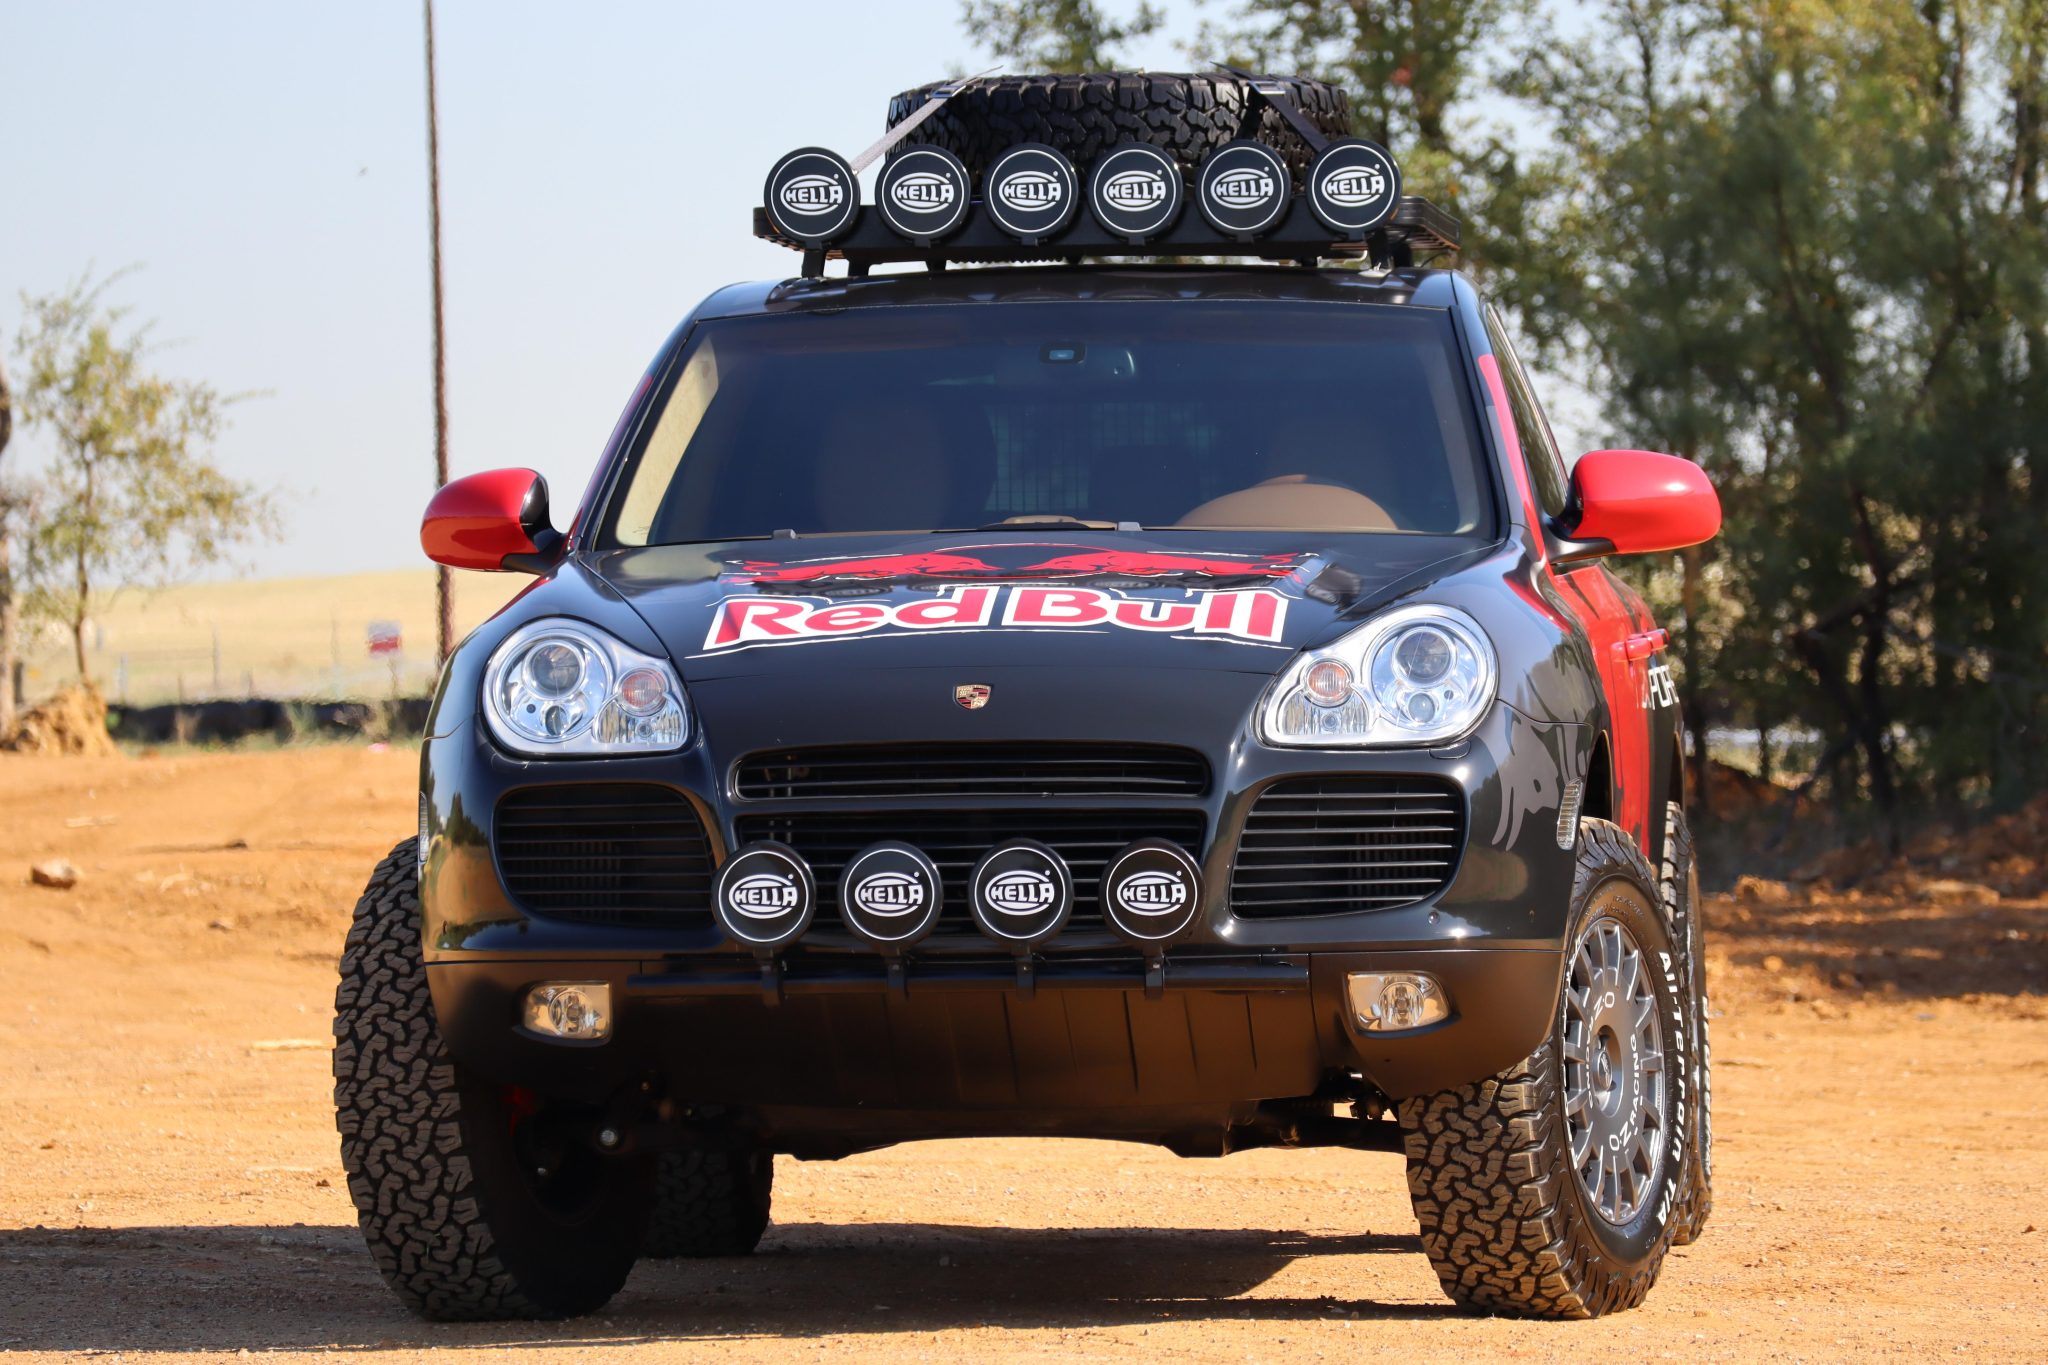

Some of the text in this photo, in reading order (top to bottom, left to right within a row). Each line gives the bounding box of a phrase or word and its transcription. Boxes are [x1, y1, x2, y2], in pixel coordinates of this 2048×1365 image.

[785, 184, 843, 204] HELLA
[896, 183, 955, 203] HELLA
[1003, 182, 1062, 201] HELLA
[1108, 181, 1166, 200] HELLA
[1215, 177, 1274, 197] HELLA
[1326, 175, 1385, 195] HELLA
[704, 585, 1289, 650] Red Bull
[734, 886, 798, 907] HELLA
[860, 884, 924, 906] HELLA
[990, 882, 1055, 903] HELLA
[1121, 883, 1187, 905] HELLA
[1629, 1033, 1640, 1127] RACING
